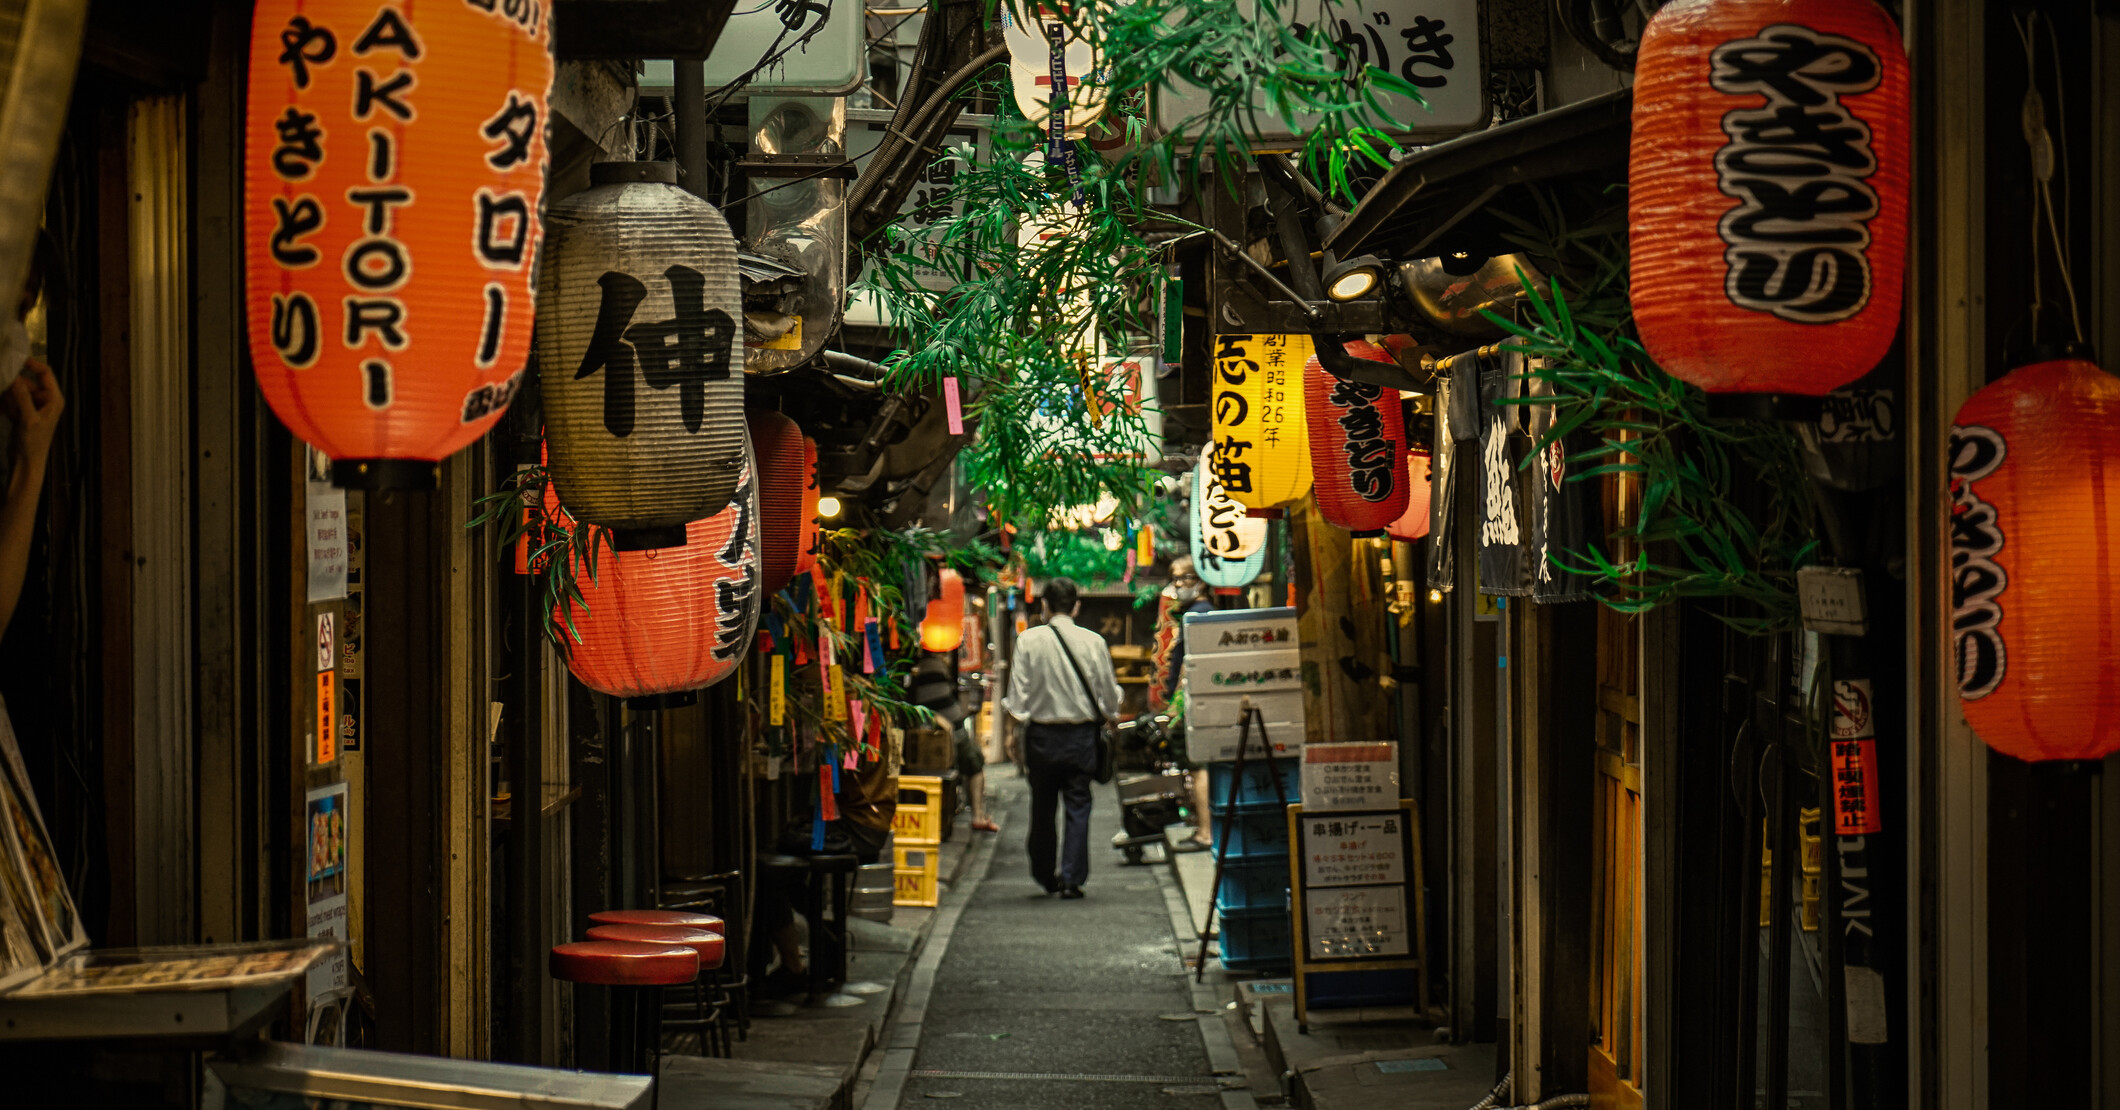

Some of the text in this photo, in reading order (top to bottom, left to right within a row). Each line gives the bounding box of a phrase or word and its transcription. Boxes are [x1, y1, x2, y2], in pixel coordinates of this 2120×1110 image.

[272, 15, 338, 367] やきとり
[346, 8, 421, 409] AKITORI
[1709, 24, 1882, 325] やきとり
[574, 264, 737, 438] 伸
[1835, 743, 1868, 828] 路上喫煙禁止
